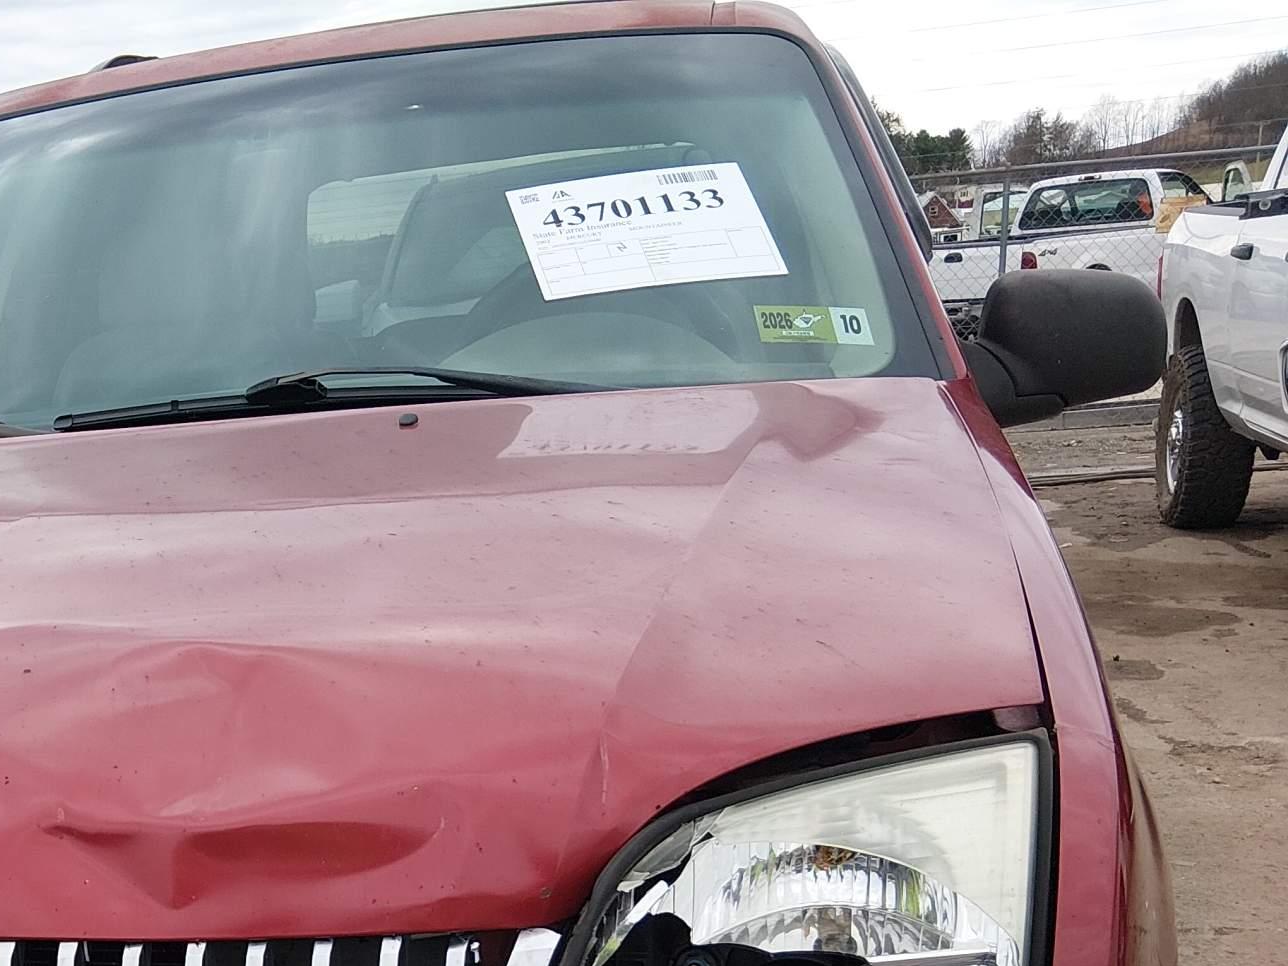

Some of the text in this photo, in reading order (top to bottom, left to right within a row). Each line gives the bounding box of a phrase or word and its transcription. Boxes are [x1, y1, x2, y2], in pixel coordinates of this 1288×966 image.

[543, 188, 725, 227] 43701133
[760, 311, 862, 335] 2026 10
